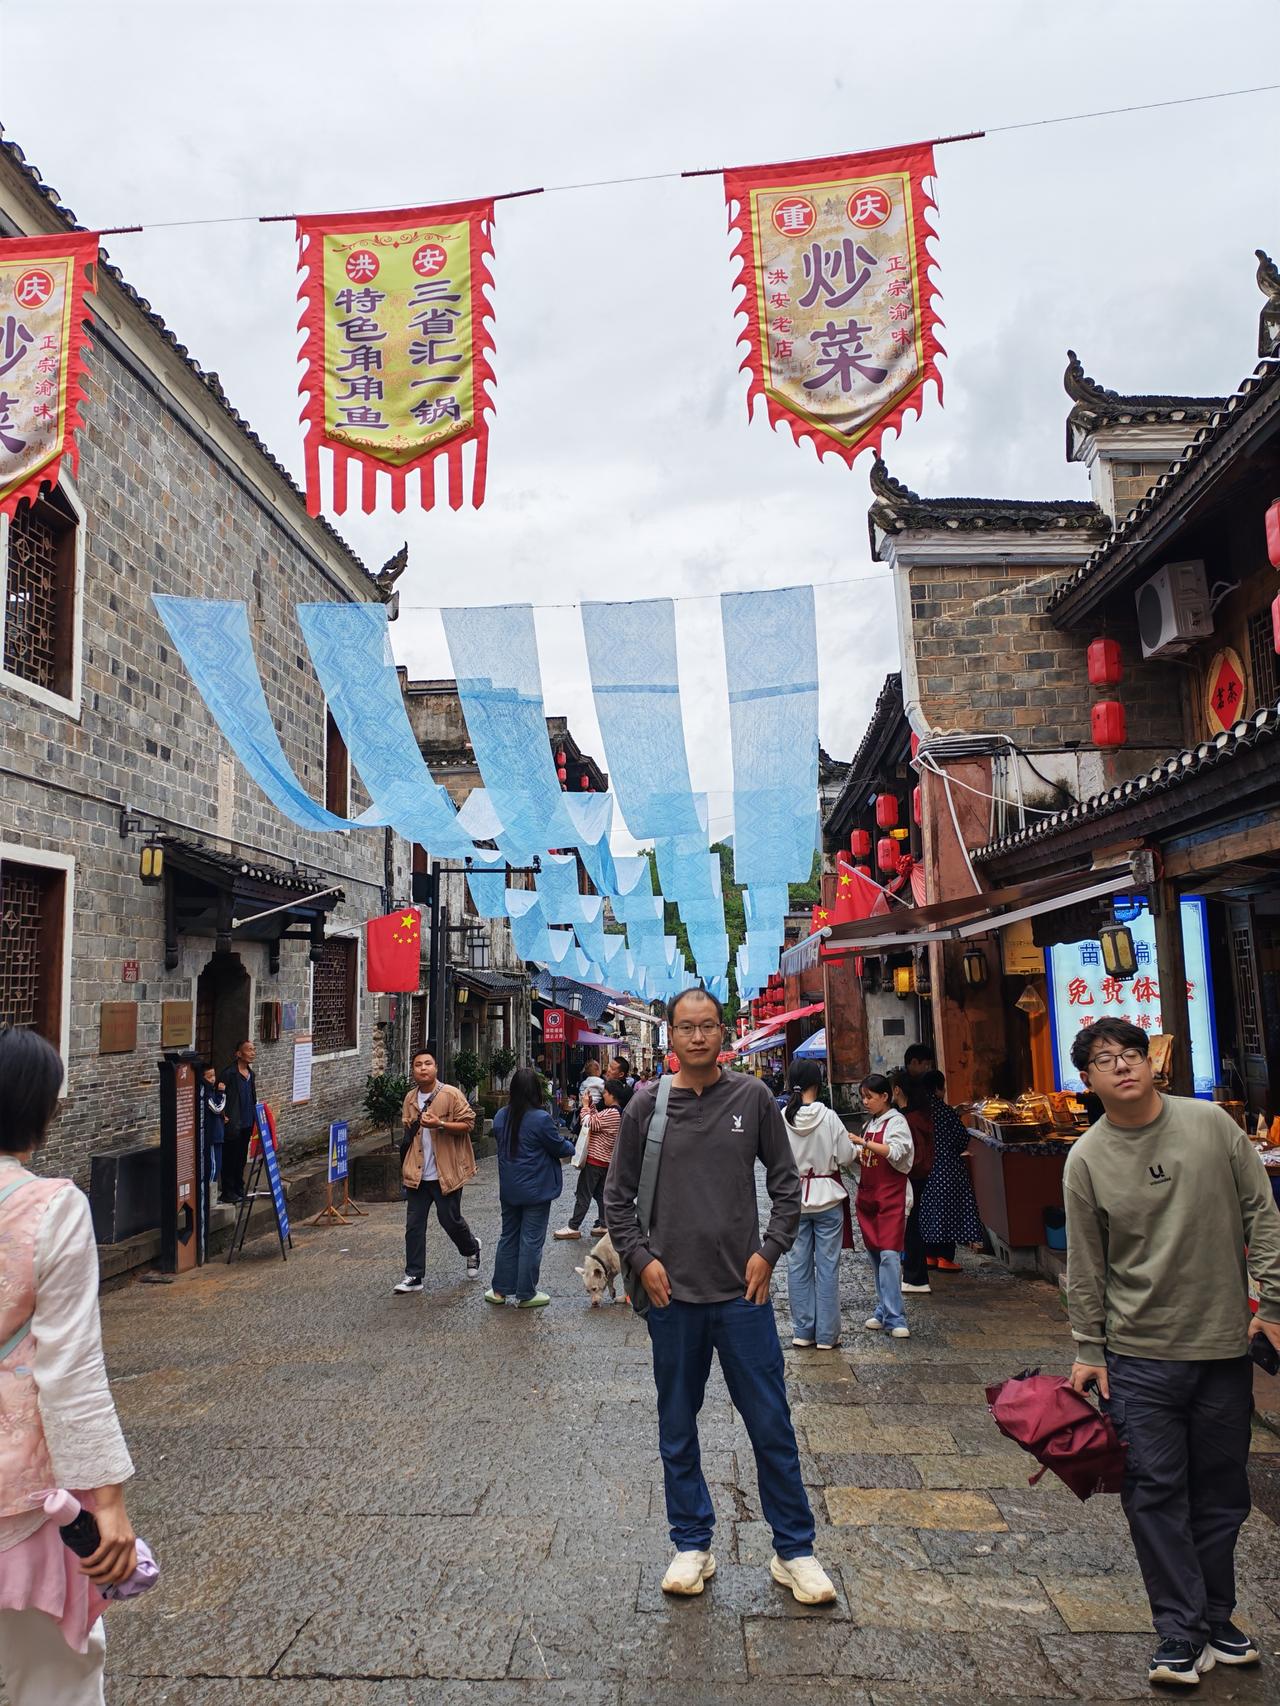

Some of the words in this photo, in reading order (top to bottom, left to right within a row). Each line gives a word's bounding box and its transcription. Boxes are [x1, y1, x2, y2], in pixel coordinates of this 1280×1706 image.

[776, 194, 886, 232] 重庆
[18, 277, 48, 301] 庆
[345, 248, 446, 281] 洪安
[885, 256, 913, 348] 正宗渝味
[334, 287, 389, 430] 特色角角鱼
[407, 278, 462, 426] 三省汇一锅
[767, 268, 795, 360] 洪安老店
[798, 237, 889, 393] 炒菜
[33, 335, 57, 420] 正宗渝味
